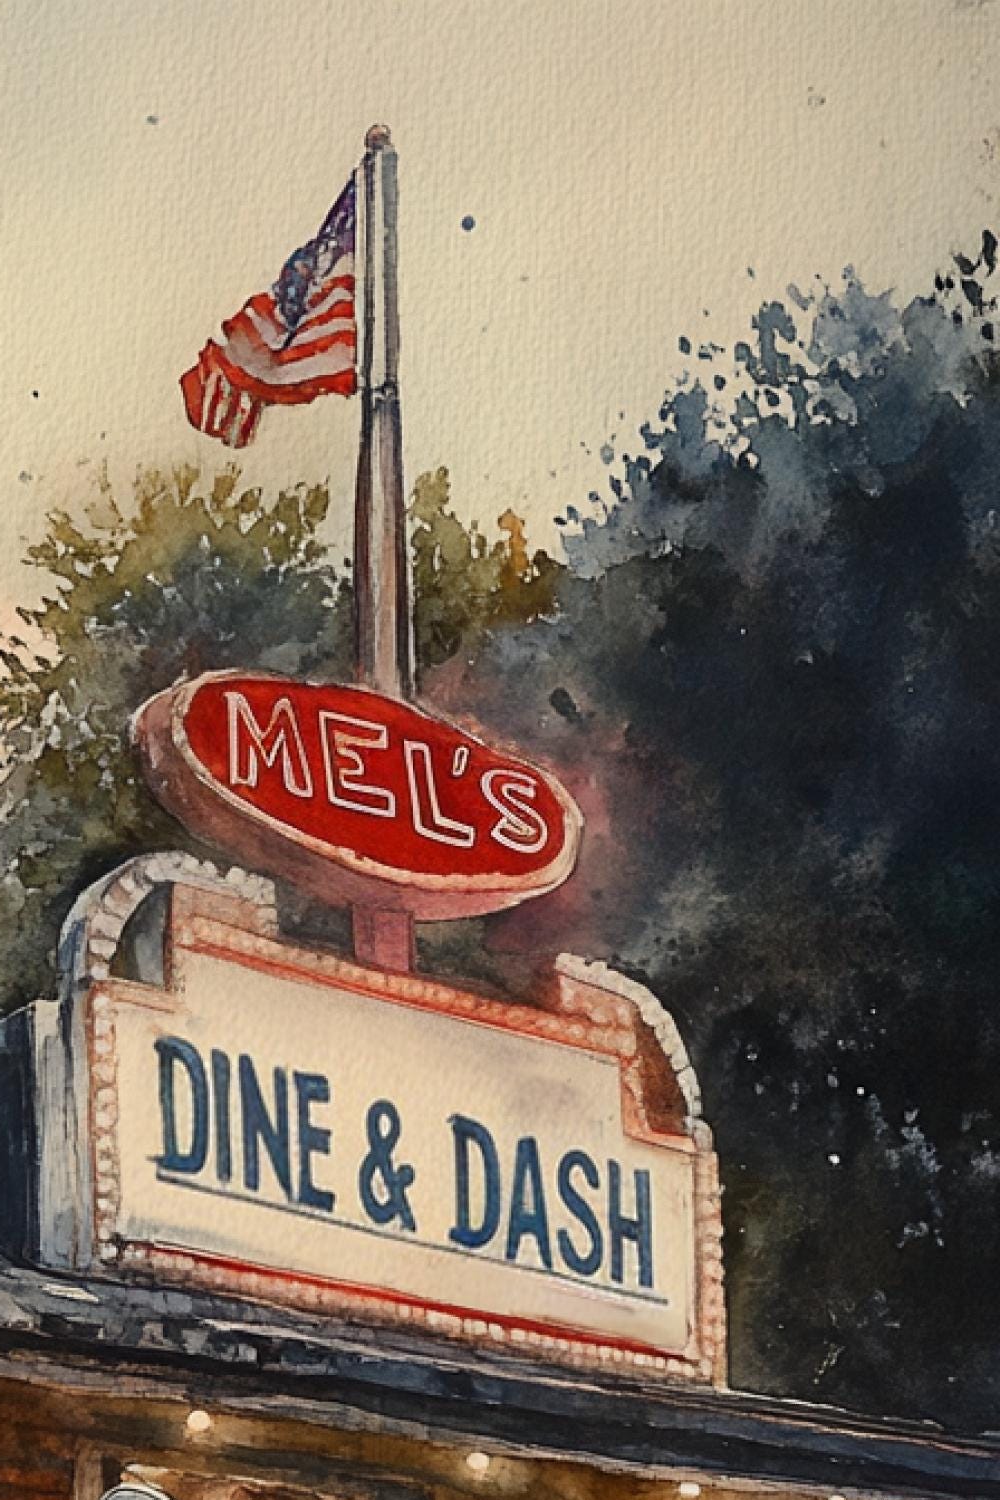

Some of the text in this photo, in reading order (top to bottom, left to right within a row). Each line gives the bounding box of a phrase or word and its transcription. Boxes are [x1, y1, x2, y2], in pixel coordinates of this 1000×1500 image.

[223, 691, 549, 854] MEL'S
[149, 1035, 653, 1289] DINE & DASH
